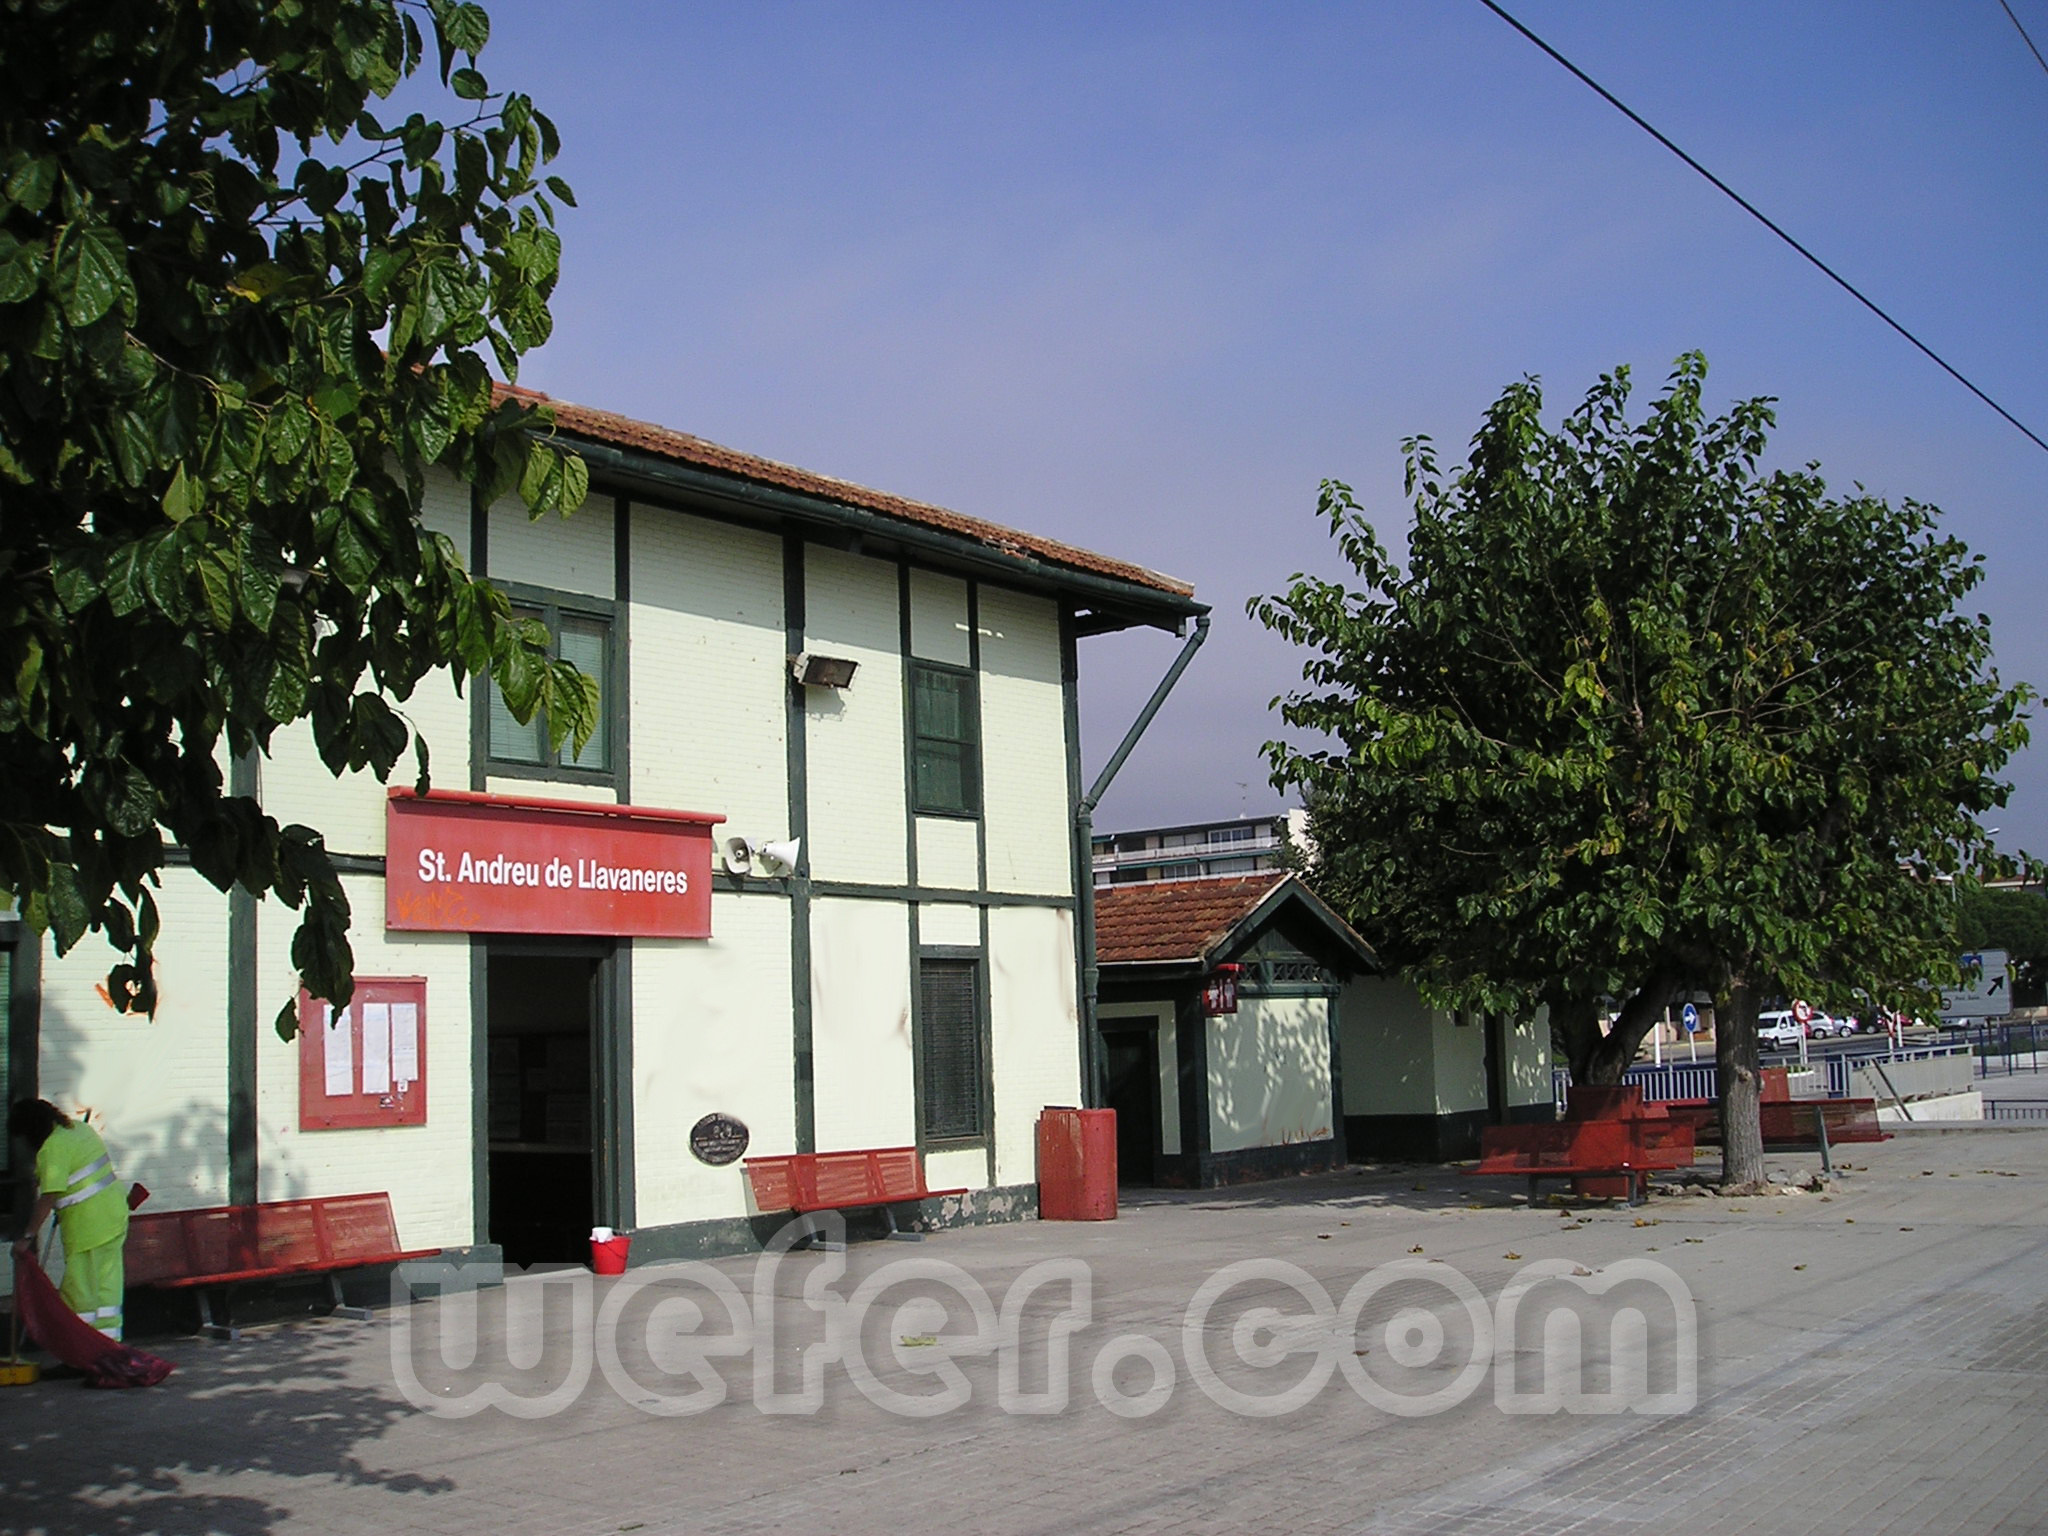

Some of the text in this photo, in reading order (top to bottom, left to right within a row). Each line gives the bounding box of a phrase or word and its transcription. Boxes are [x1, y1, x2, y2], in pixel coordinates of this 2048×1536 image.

[418, 848, 688, 894] St. Andreu de Llavaneres
